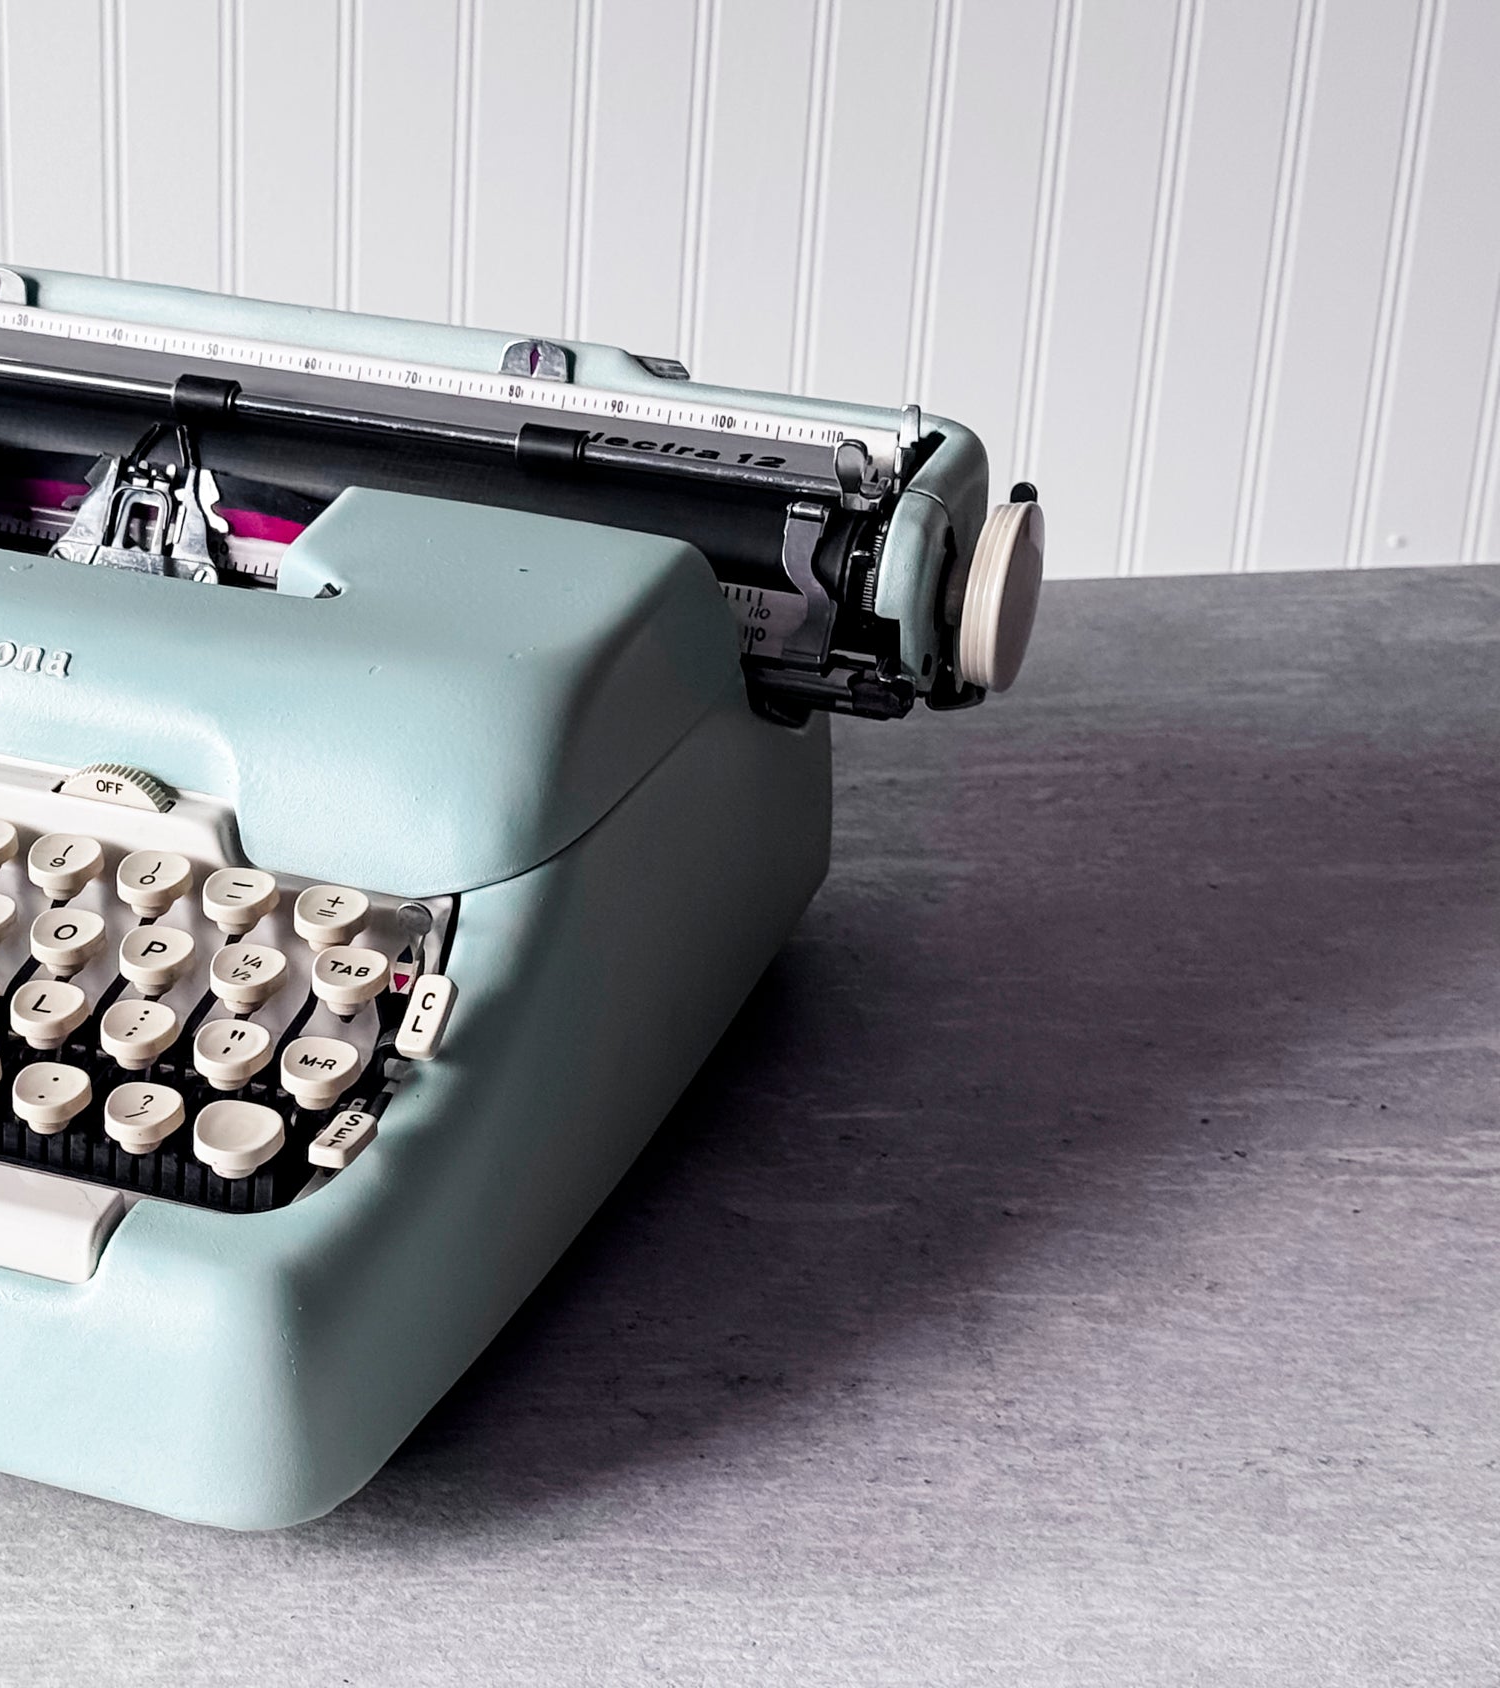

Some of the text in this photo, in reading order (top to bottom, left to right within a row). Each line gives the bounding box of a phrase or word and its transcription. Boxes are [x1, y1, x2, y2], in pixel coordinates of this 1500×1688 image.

[16, 313, 29, 327] 30
[111, 327, 123, 341] 40
[206, 344, 219, 357] 50
[304, 357, 317, 370] 60
[405, 371, 418, 385] 70
[508, 385, 521, 399] 80
[610, 400, 624, 414] 90
[714, 414, 734, 429] 100
[826, 430, 845, 444] 110
[583, 430, 787, 468] lectra 12
[748, 606, 771, 620] 110
[743, 626, 767, 642] 110
[96, 779, 124, 795] OFF
[49, 856, 66, 868] 9
[326, 896, 345, 908] +
[53, 923, 78, 941] O
[140, 940, 168, 957] P
[330, 960, 371, 978] TAB
[31, 993, 52, 1014] L
[298, 1054, 337, 1071] M-R
[142, 1094, 155, 1109] ?
